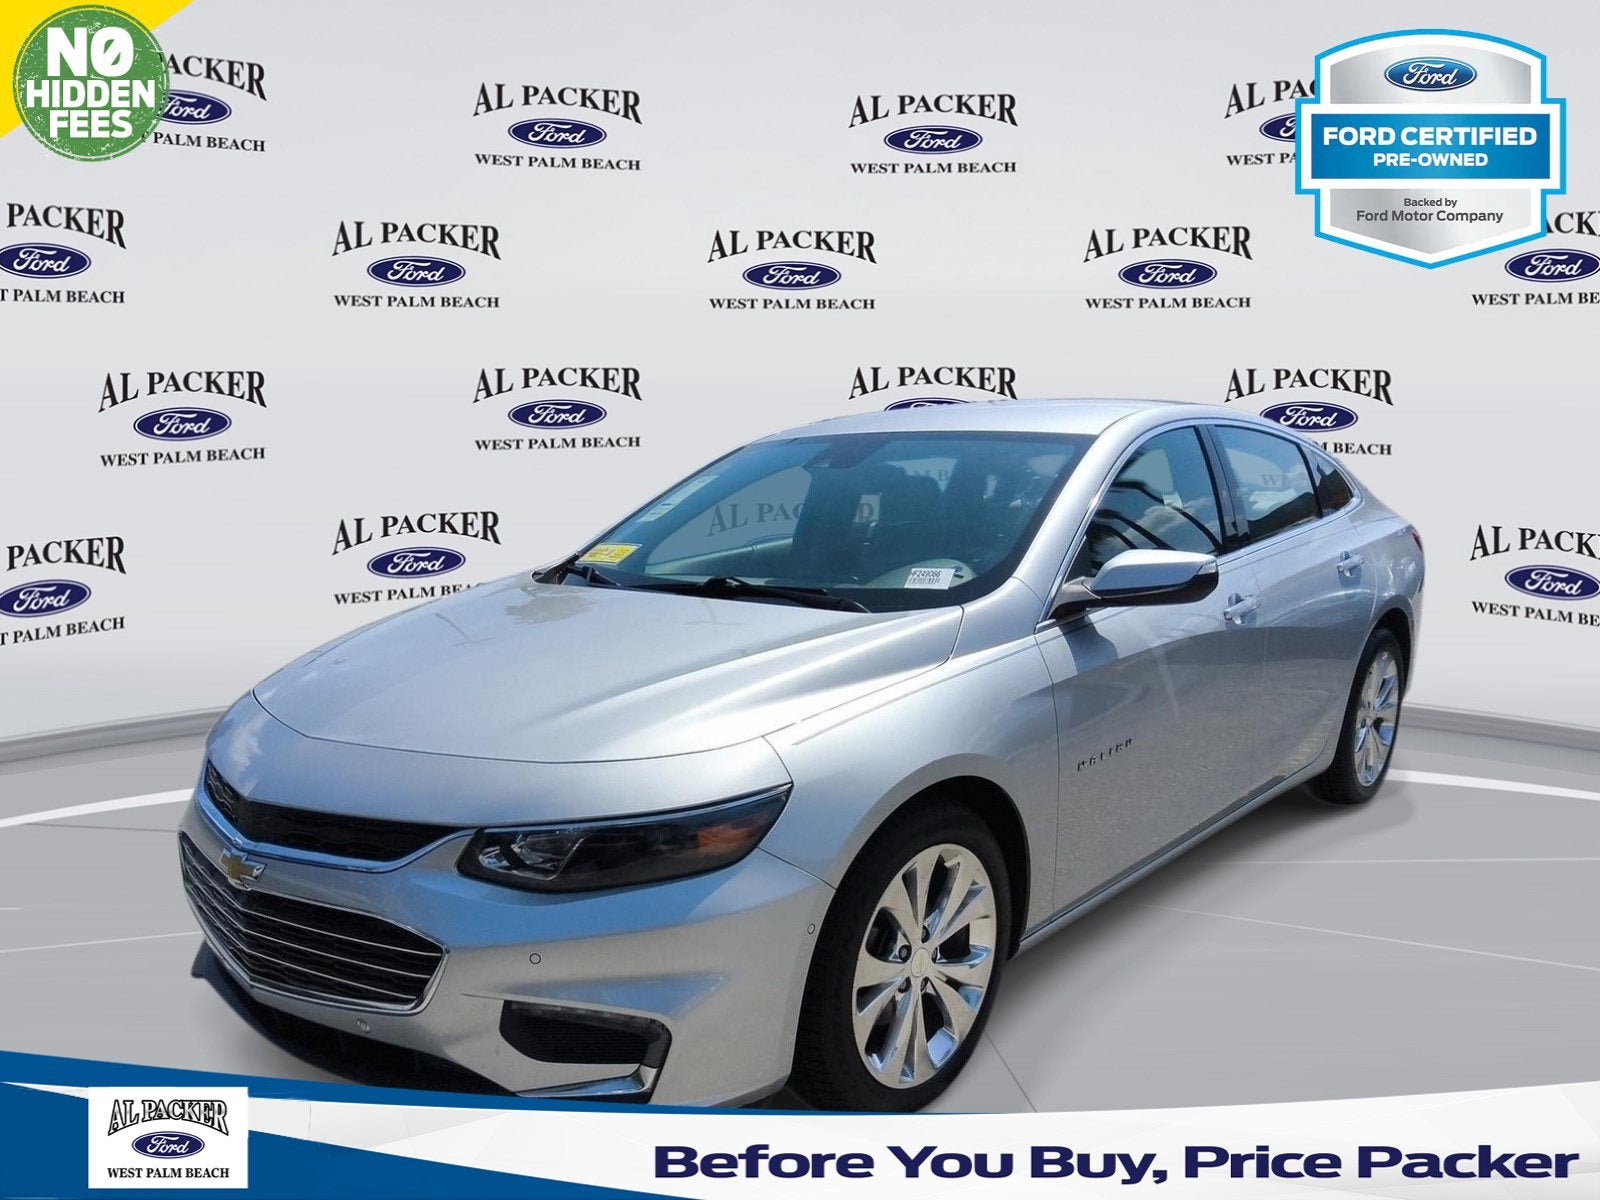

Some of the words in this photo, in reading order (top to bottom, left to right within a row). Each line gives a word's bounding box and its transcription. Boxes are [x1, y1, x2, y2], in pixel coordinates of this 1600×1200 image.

[167, 53, 267, 102] ACKER
[473, 82, 513, 117] AL
[521, 84, 643, 125] PACKER
[848, 95, 890, 129] AL
[897, 93, 1019, 127] PACKER
[1224, 82, 1266, 120] AL
[153, 131, 202, 148] PALM
[206, 136, 266, 152] BEACH
[528, 123, 586, 144] Ford
[904, 129, 961, 150] Ford
[474, 153, 523, 167] WEST
[528, 156, 577, 169] PALM
[581, 158, 641, 171] BEACH
[850, 163, 900, 174] WEST
[904, 162, 952, 174] PALM
[957, 161, 1017, 173] BEACH
[1226, 152, 1276, 166] WEST
[6, 202, 127, 250] PACKER
[332, 220, 373, 257] AL
[380, 221, 502, 260] PACKER
[707, 229, 749, 264] AL
[756, 230, 878, 265] PACKER
[1083, 228, 1125, 263] AL
[1132, 225, 1253, 260] PACKER
[13, 247, 71, 273] Ford
[388, 260, 446, 283] Ford
[1525, 254, 1583, 276] Ford
[763, 265, 821, 285] Ford
[1139, 263, 1197, 284] Ford
[13, 288, 61, 303] PALM
[66, 290, 125, 304] BEACH
[333, 294, 383, 307] WEST
[387, 295, 435, 308] PALM
[440, 296, 500, 309] BEACH
[709, 298, 759, 310] WEST
[762, 298, 811, 310] PALM
[816, 298, 876, 310] BEACH
[1085, 297, 1135, 309] WEST
[1138, 297, 1187, 309] PALM
[1192, 296, 1251, 309] BEACH
[1472, 293, 1520, 306] WEST
[1525, 292, 1573, 305] PALM
[98, 372, 140, 413] AL
[146, 370, 268, 408] PACKER
[473, 368, 514, 404] AL
[521, 367, 643, 402] PACKER
[848, 366, 890, 400] AL
[897, 366, 1019, 400] PACKER
[1224, 368, 1266, 403] AL
[1272, 368, 1394, 406] PACKER
[153, 413, 212, 436] Ford
[528, 404, 586, 425] Ford
[1279, 406, 1338, 427] Ford
[474, 438, 524, 451] WEST
[528, 437, 577, 450] PALM
[581, 436, 641, 449] BEACH
[1333, 442, 1392, 456] BEACH
[100, 452, 149, 467] WEST
[153, 450, 202, 465] PALM
[206, 447, 266, 462] BEACH
[707, 504, 749, 537] AL
[332, 518, 373, 556] AL
[380, 510, 502, 546] PACKER
[1469, 524, 1511, 562] AL
[1517, 527, 1600, 561] PACK
[6, 536, 127, 575] PACKER
[387, 552, 446, 574] Ford
[1525, 570, 1582, 596] Ford
[13, 585, 71, 612] Ford
[334, 590, 383, 605] WEST
[387, 585, 436, 601] PALM
[1471, 600, 1521, 617] WEST
[1525, 606, 1573, 624] PALM
[13, 624, 61, 644] PALM
[66, 616, 125, 637] BEACH
